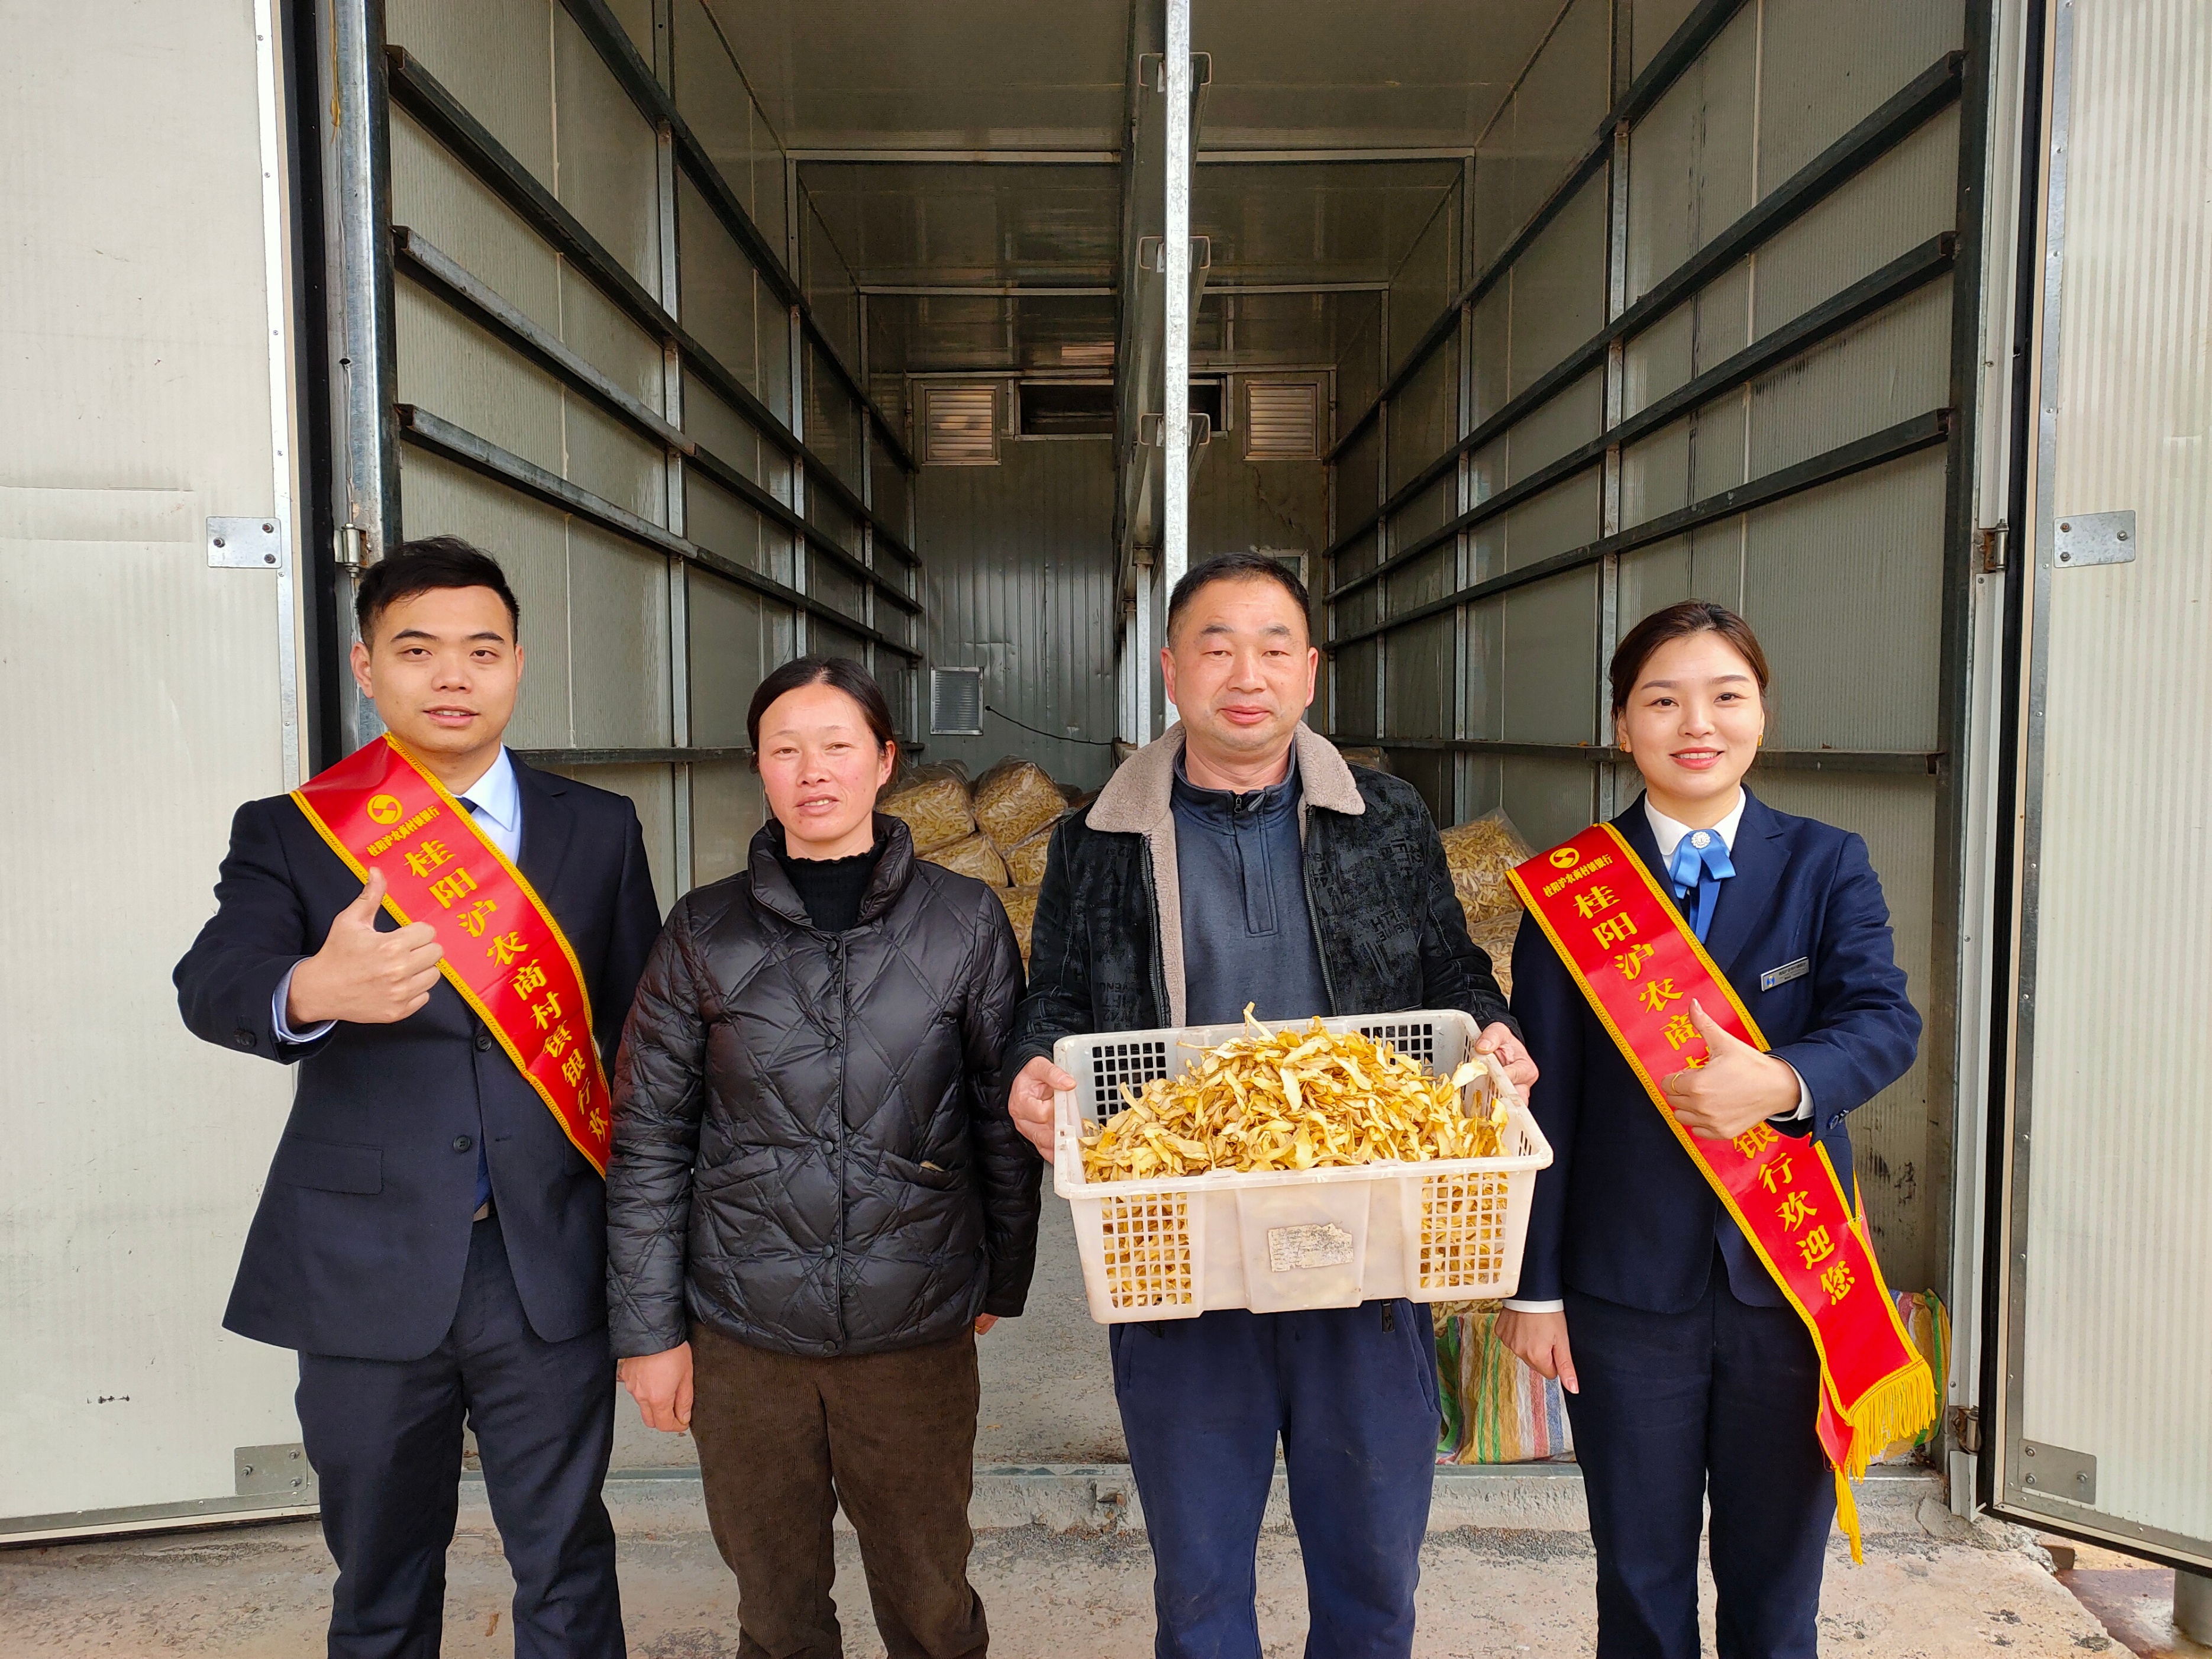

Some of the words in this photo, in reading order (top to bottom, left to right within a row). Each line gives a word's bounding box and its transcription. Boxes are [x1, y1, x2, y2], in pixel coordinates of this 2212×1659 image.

[366, 805, 440, 857] 桂阳沪农商村镇银行
[1542, 854, 1613, 898] 桂阳沪农商村镇银行
[1572, 885, 1856, 1306] 桂阳沪农商银行欢迎您
